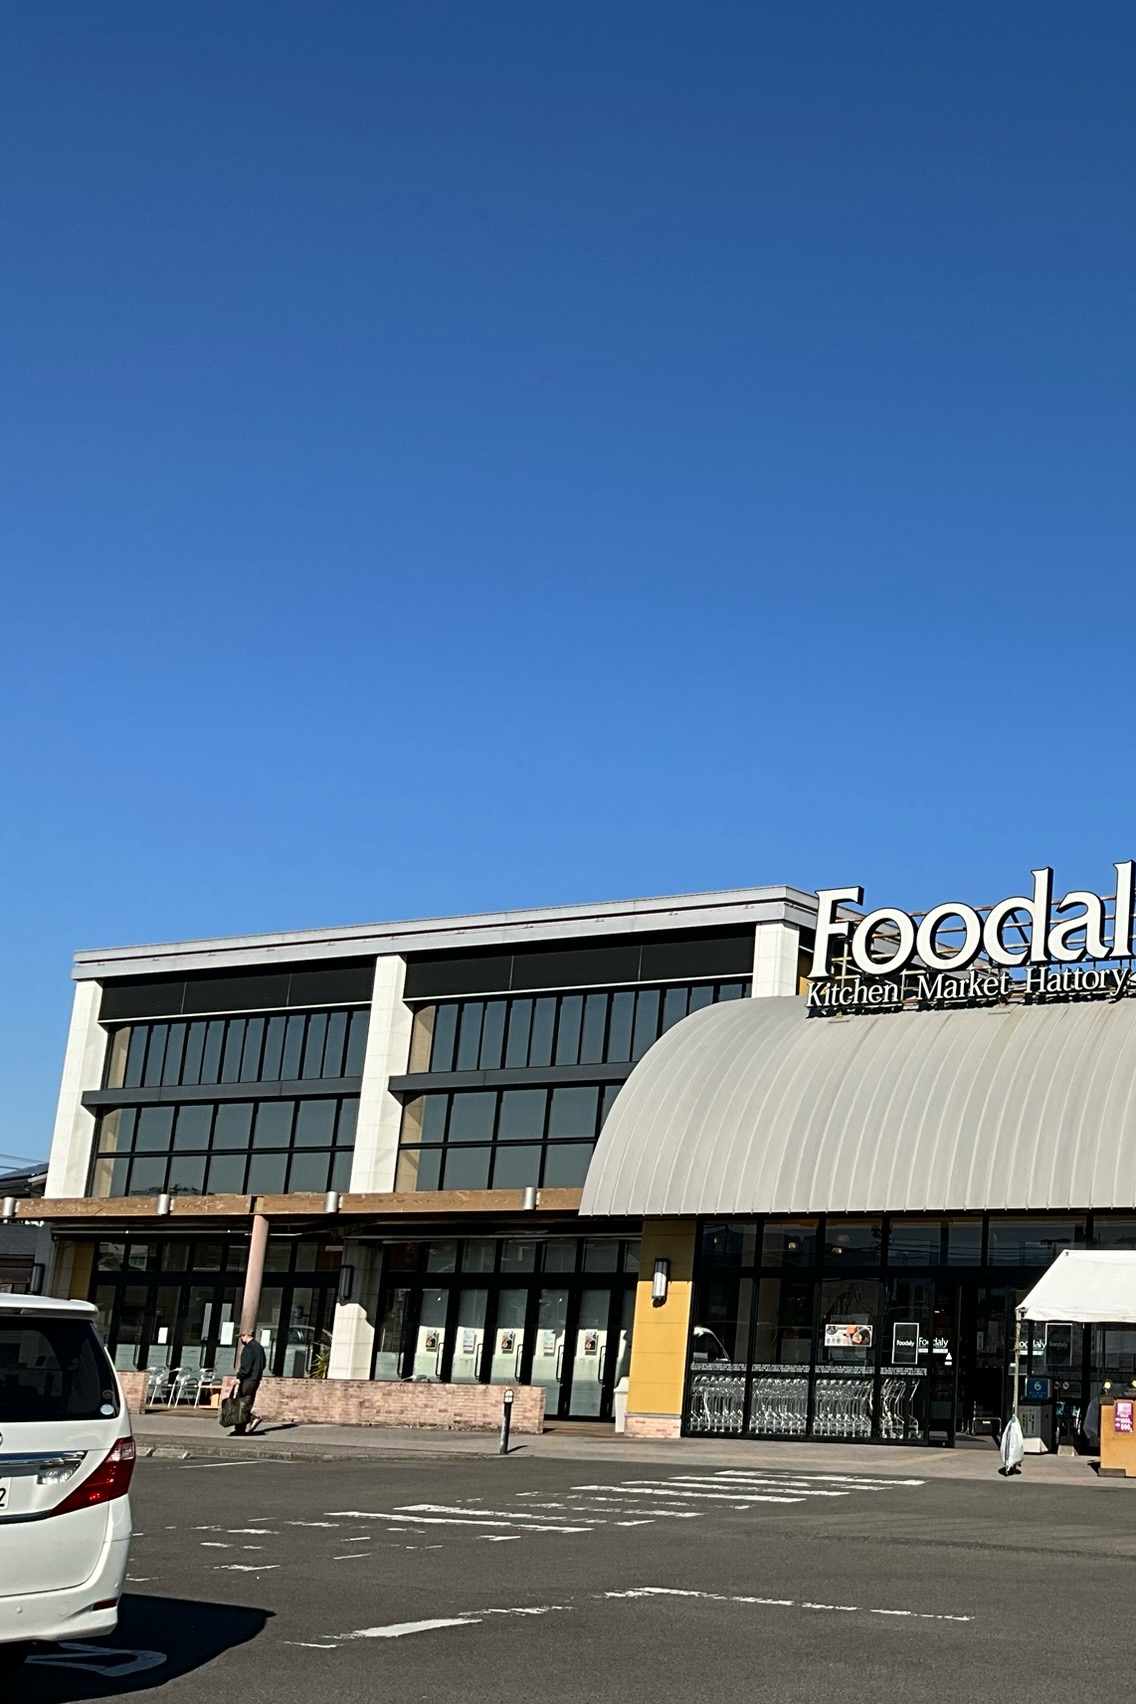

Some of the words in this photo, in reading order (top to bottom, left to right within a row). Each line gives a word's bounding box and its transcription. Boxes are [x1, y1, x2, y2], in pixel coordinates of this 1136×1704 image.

[806, 980, 899, 1008] Kitchen
[916, 970, 1010, 1001] Market
[1025, 966, 1130, 1000] Hattory
